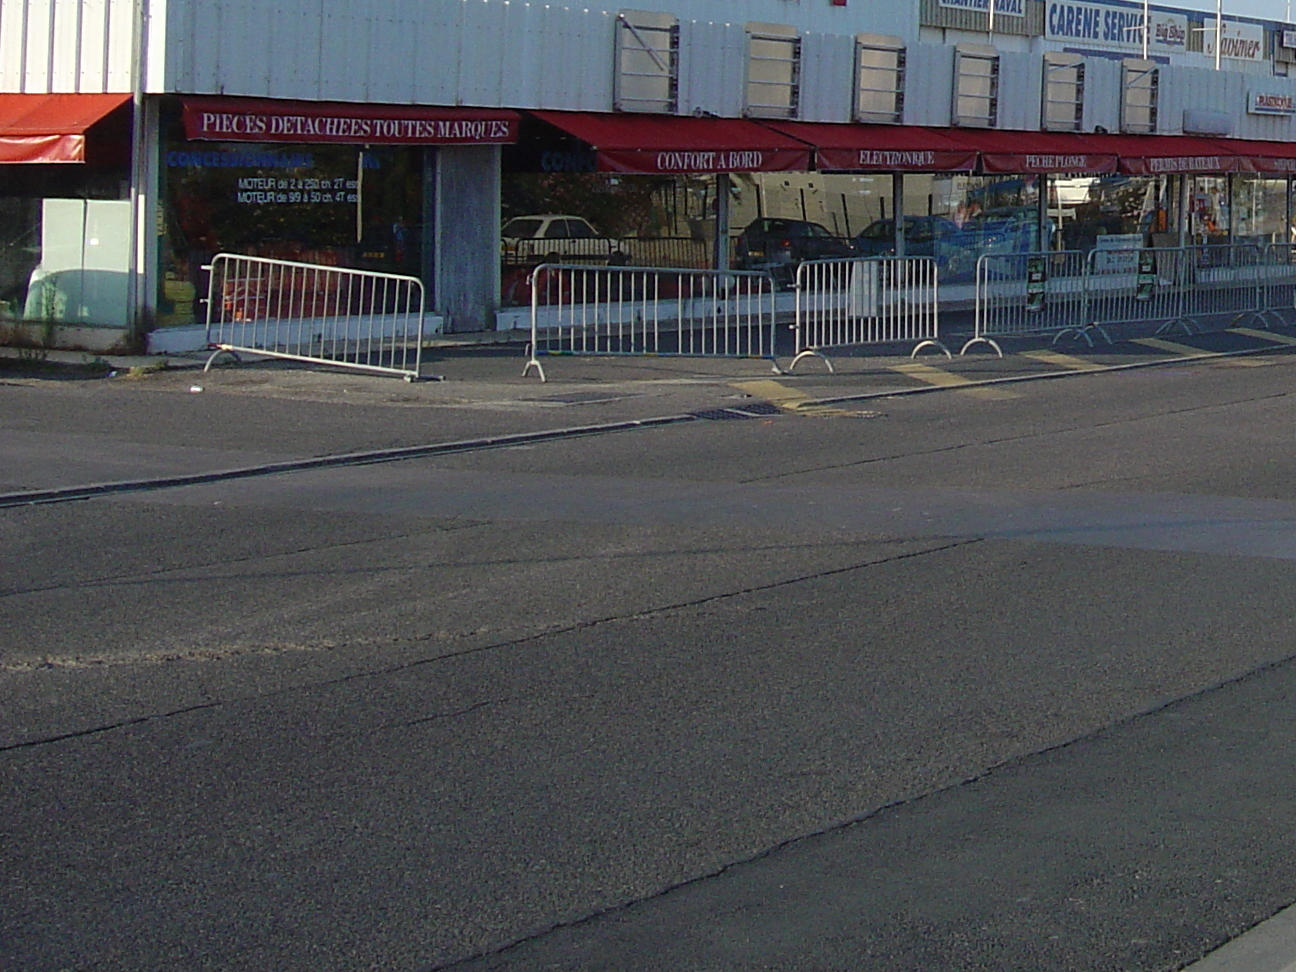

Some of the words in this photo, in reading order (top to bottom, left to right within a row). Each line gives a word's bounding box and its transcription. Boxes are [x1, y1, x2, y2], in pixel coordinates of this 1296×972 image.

[1049, 3, 1100, 40] CARENE
[1103, 9, 1151, 45] SERVICE
[270, 116, 370, 137] DETACHEES
[373, 119, 434, 138] TOUTES
[437, 120, 509, 140] MARQUES
[657, 152, 715, 170] CONFORT
[717, 152, 726, 169] A
[729, 151, 763, 169] BORD
[859, 150, 935, 167] ELECTRONIQUE
[1026, 154, 1054, 168] PECHE
[239, 178, 275, 189] MOTEUR
[278, 178, 288, 189] de
[238, 192, 275, 203] MOTEUR
[276, 192, 287, 203] de
[310, 192, 321, 203] 50
[335, 192, 345, 203] 4T
